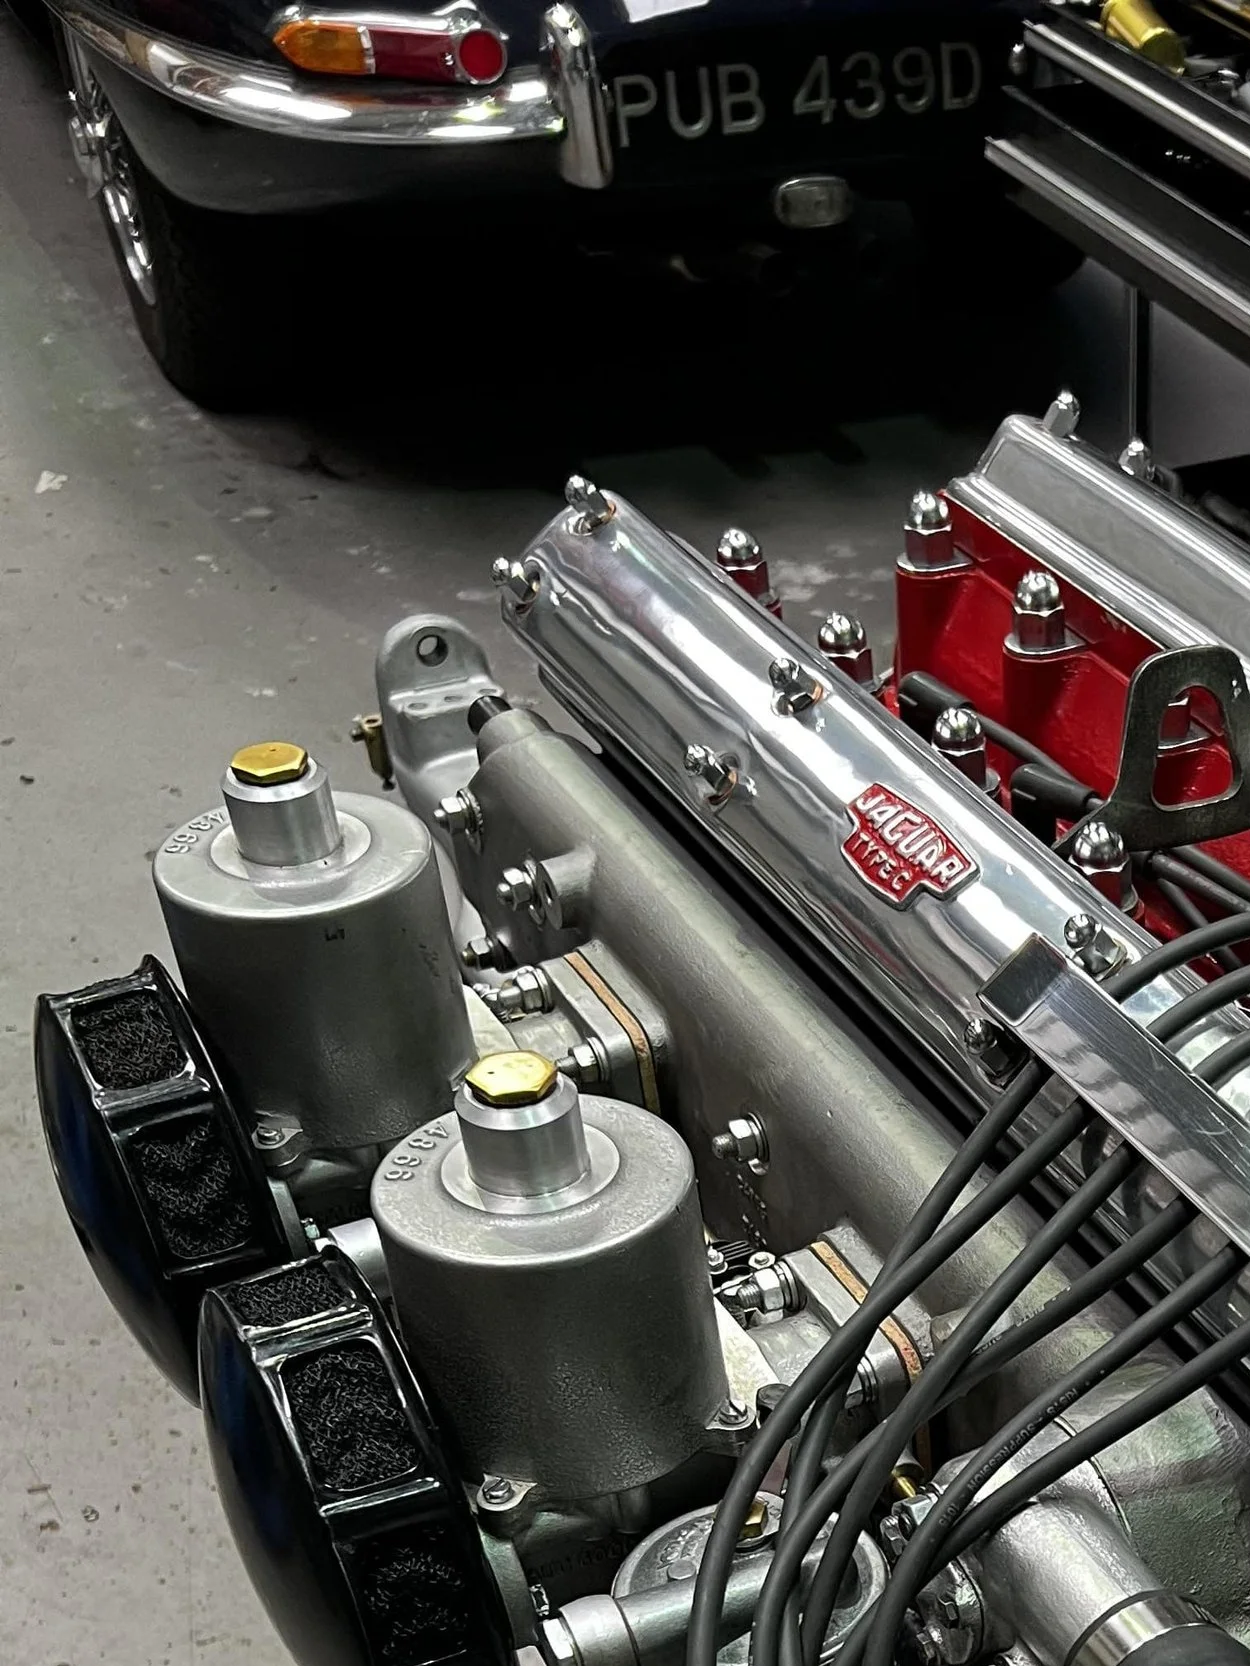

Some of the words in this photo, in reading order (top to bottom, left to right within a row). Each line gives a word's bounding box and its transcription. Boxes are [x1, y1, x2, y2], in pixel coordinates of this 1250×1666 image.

[613, 62, 766, 148] PUB
[793, 41, 982, 124] 439D
[852, 833, 897, 879] TYPE
[856, 793, 966, 884] JAGUAR
[967, 1422, 1038, 1492] SUPPRESSION
